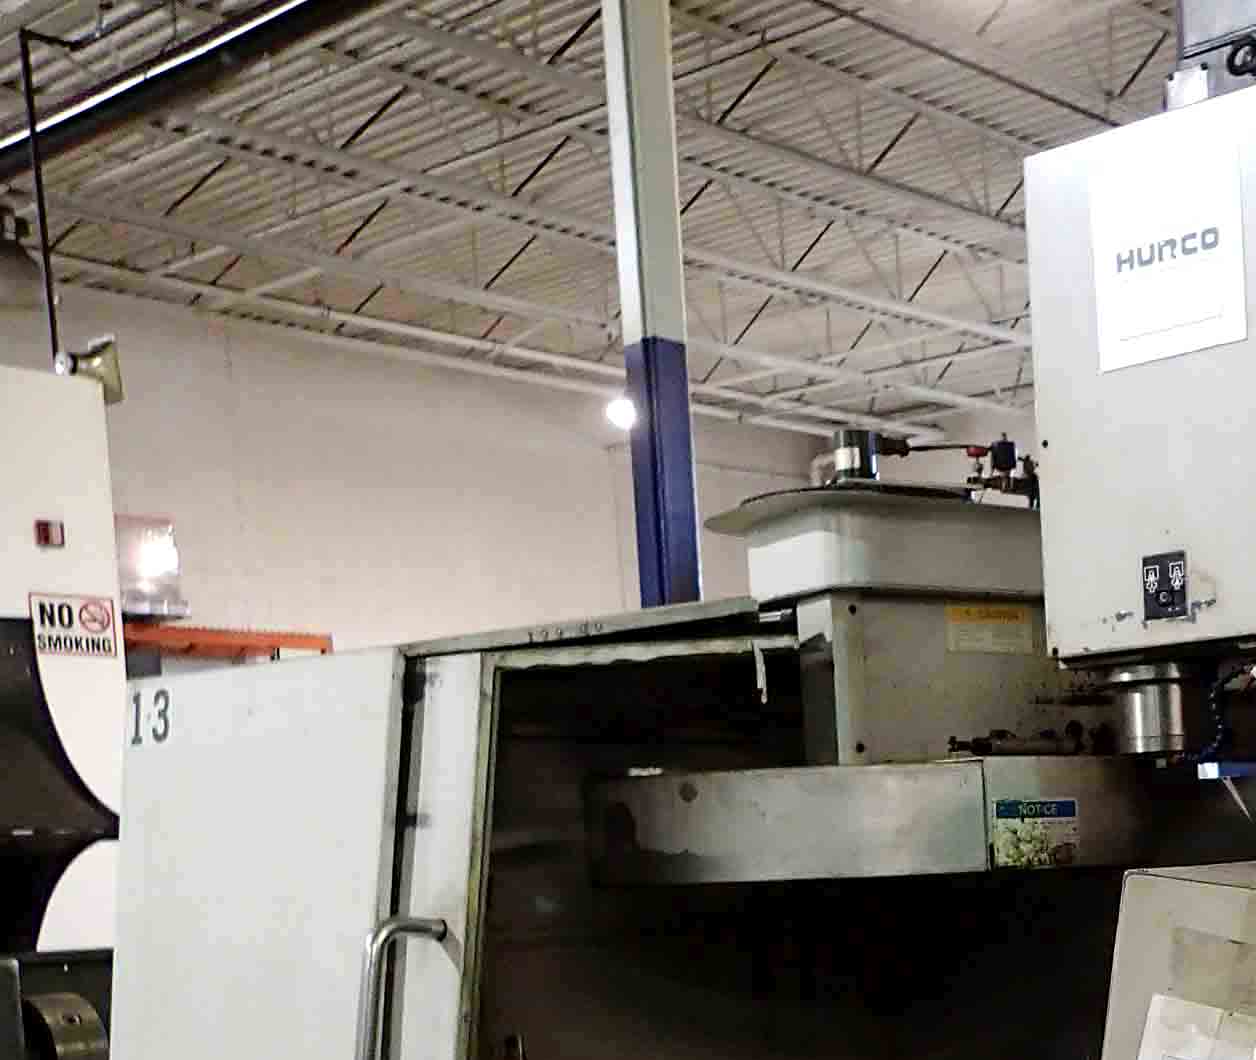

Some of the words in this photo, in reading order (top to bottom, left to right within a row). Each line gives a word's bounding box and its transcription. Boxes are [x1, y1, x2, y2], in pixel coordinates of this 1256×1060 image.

[1116, 226, 1219, 273] HURCO
[38, 602, 74, 629] NO
[37, 634, 113, 653] SMOKING
[131, 688, 170, 745] 13
